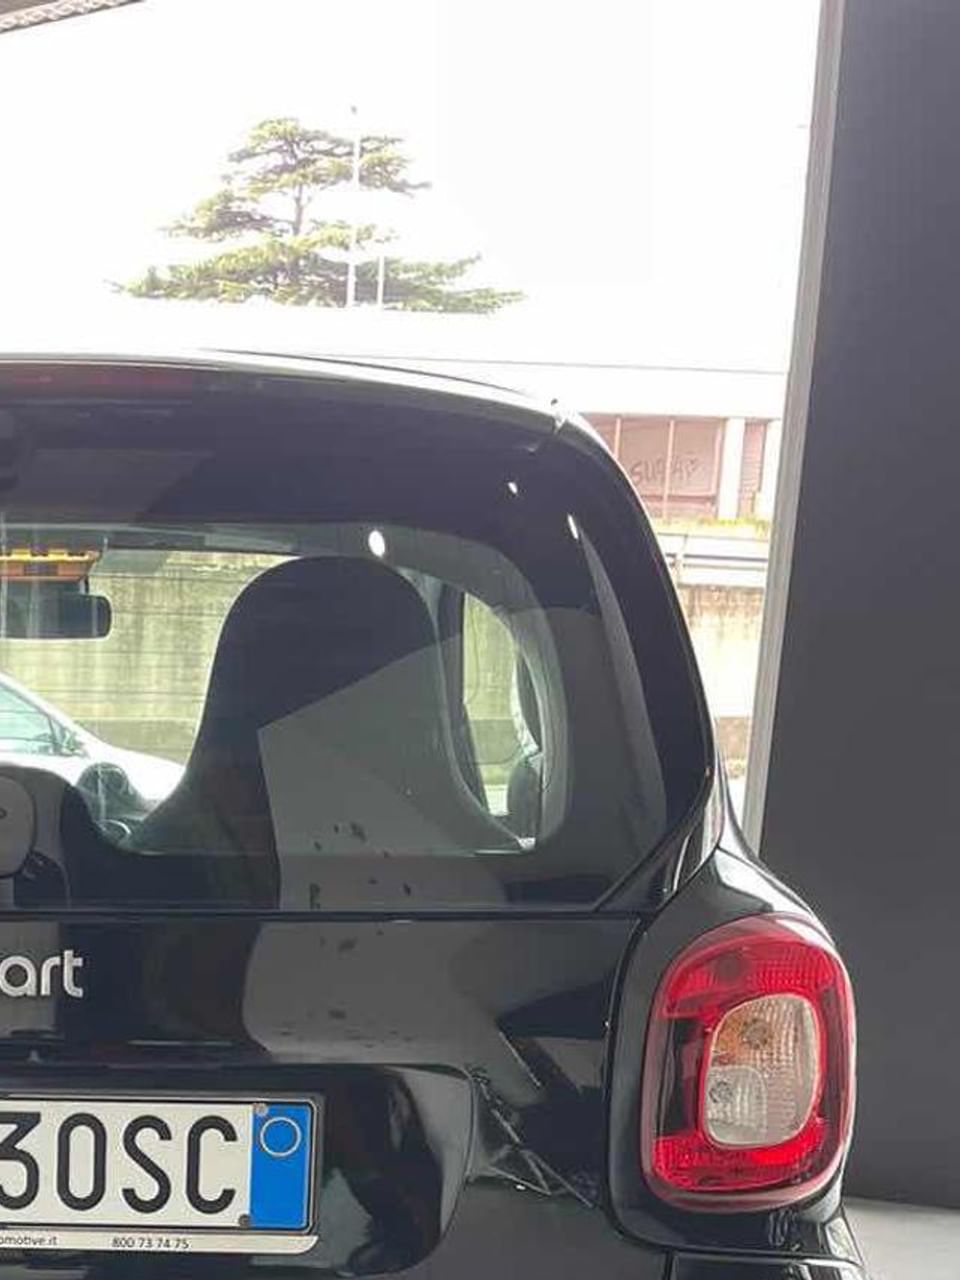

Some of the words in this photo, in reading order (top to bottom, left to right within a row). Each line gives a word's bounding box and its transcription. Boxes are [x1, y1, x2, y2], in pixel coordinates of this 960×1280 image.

[112, 1236, 135, 1248] 800
[138, 1237, 153, 1248] 73
[156, 1238, 171, 1249] 74
[174, 1238, 190, 1249] 75
